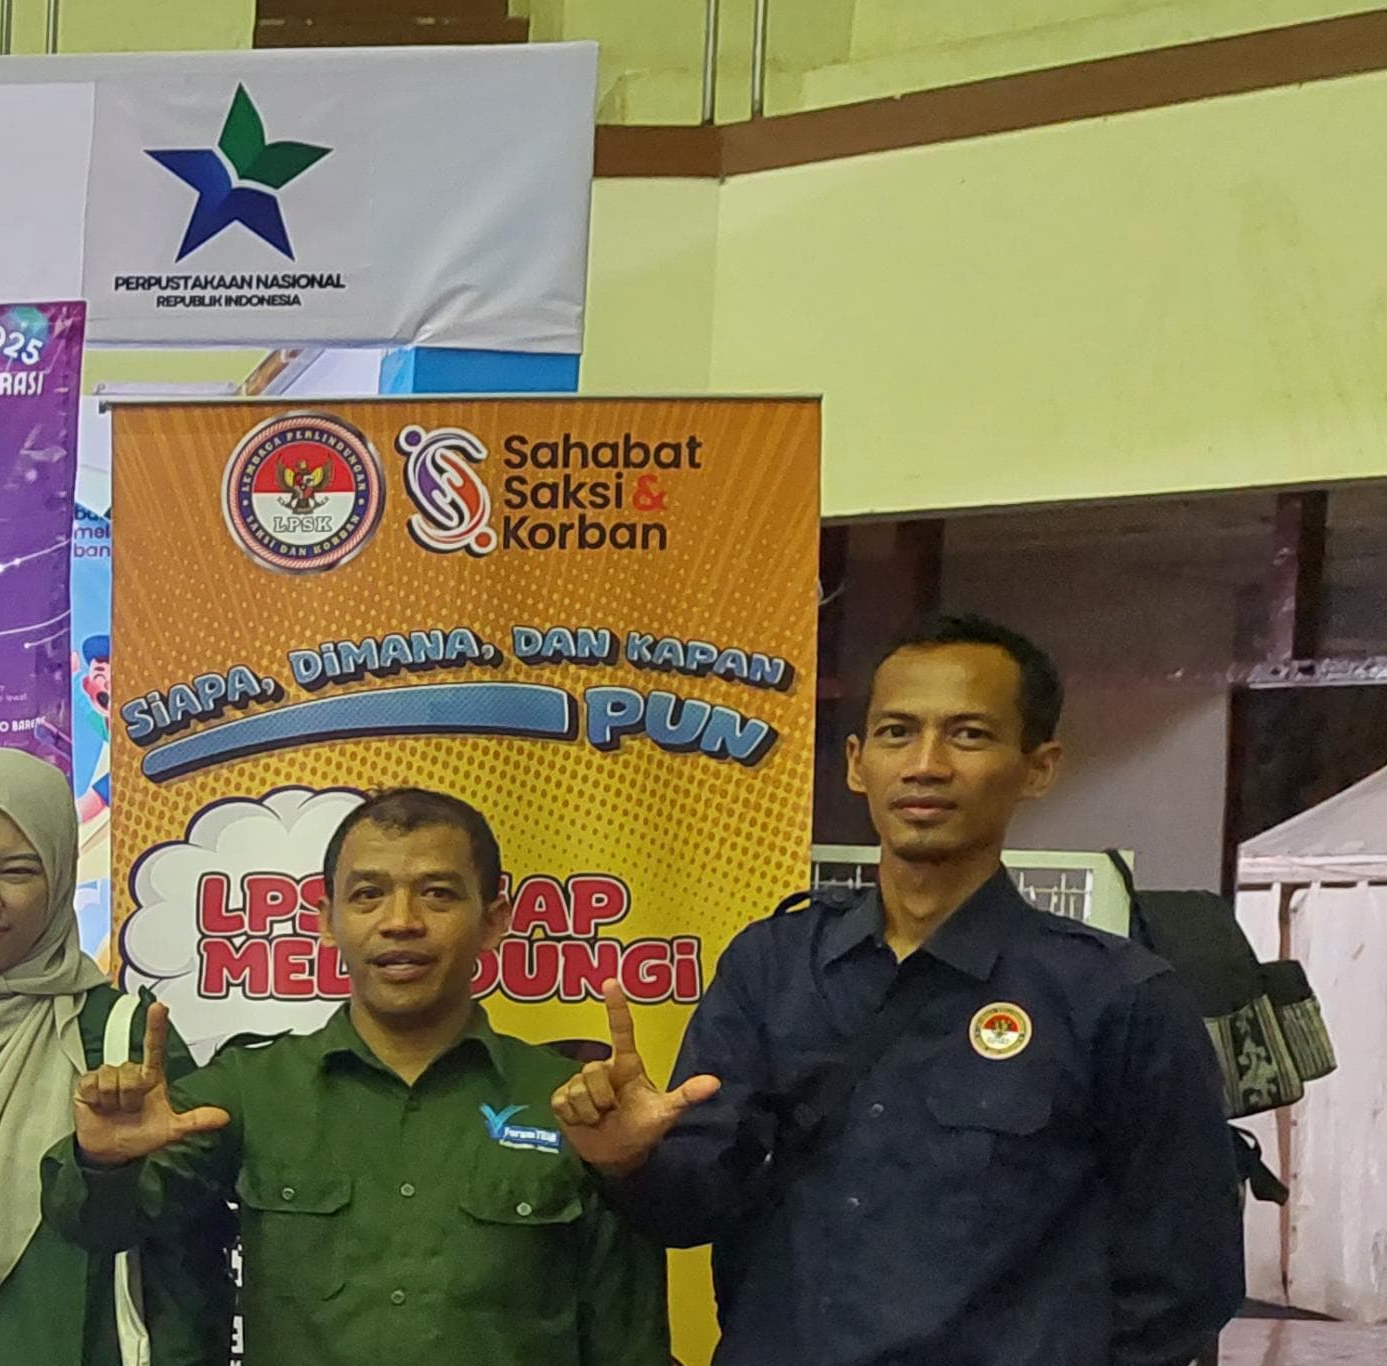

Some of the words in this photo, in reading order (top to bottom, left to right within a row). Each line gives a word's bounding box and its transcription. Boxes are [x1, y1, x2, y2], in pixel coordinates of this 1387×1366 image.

[114, 275, 254, 291] PERPUSTAKAAN
[256, 273, 345, 289] NASIONAL
[157, 295, 222, 308] REPUBLIK
[226, 294, 301, 307] INDONESIA
[242, 439, 281, 492] LEMBAGA
[286, 430, 366, 490] PERLINDUNGAN
[503, 433, 702, 470] Sahabat
[503, 474, 624, 511] Saksi
[632, 474, 667, 511] &
[246, 515, 276, 548] SAKSI
[280, 545, 307, 555] DAN
[313, 515, 360, 554] KORBAN
[274, 516, 332, 532] LPSK
[503, 515, 667, 551] Korban
[512, 625, 614, 663] DAN
[626, 629, 788, 688] KAPAN
[586, 686, 773, 763] PUN
